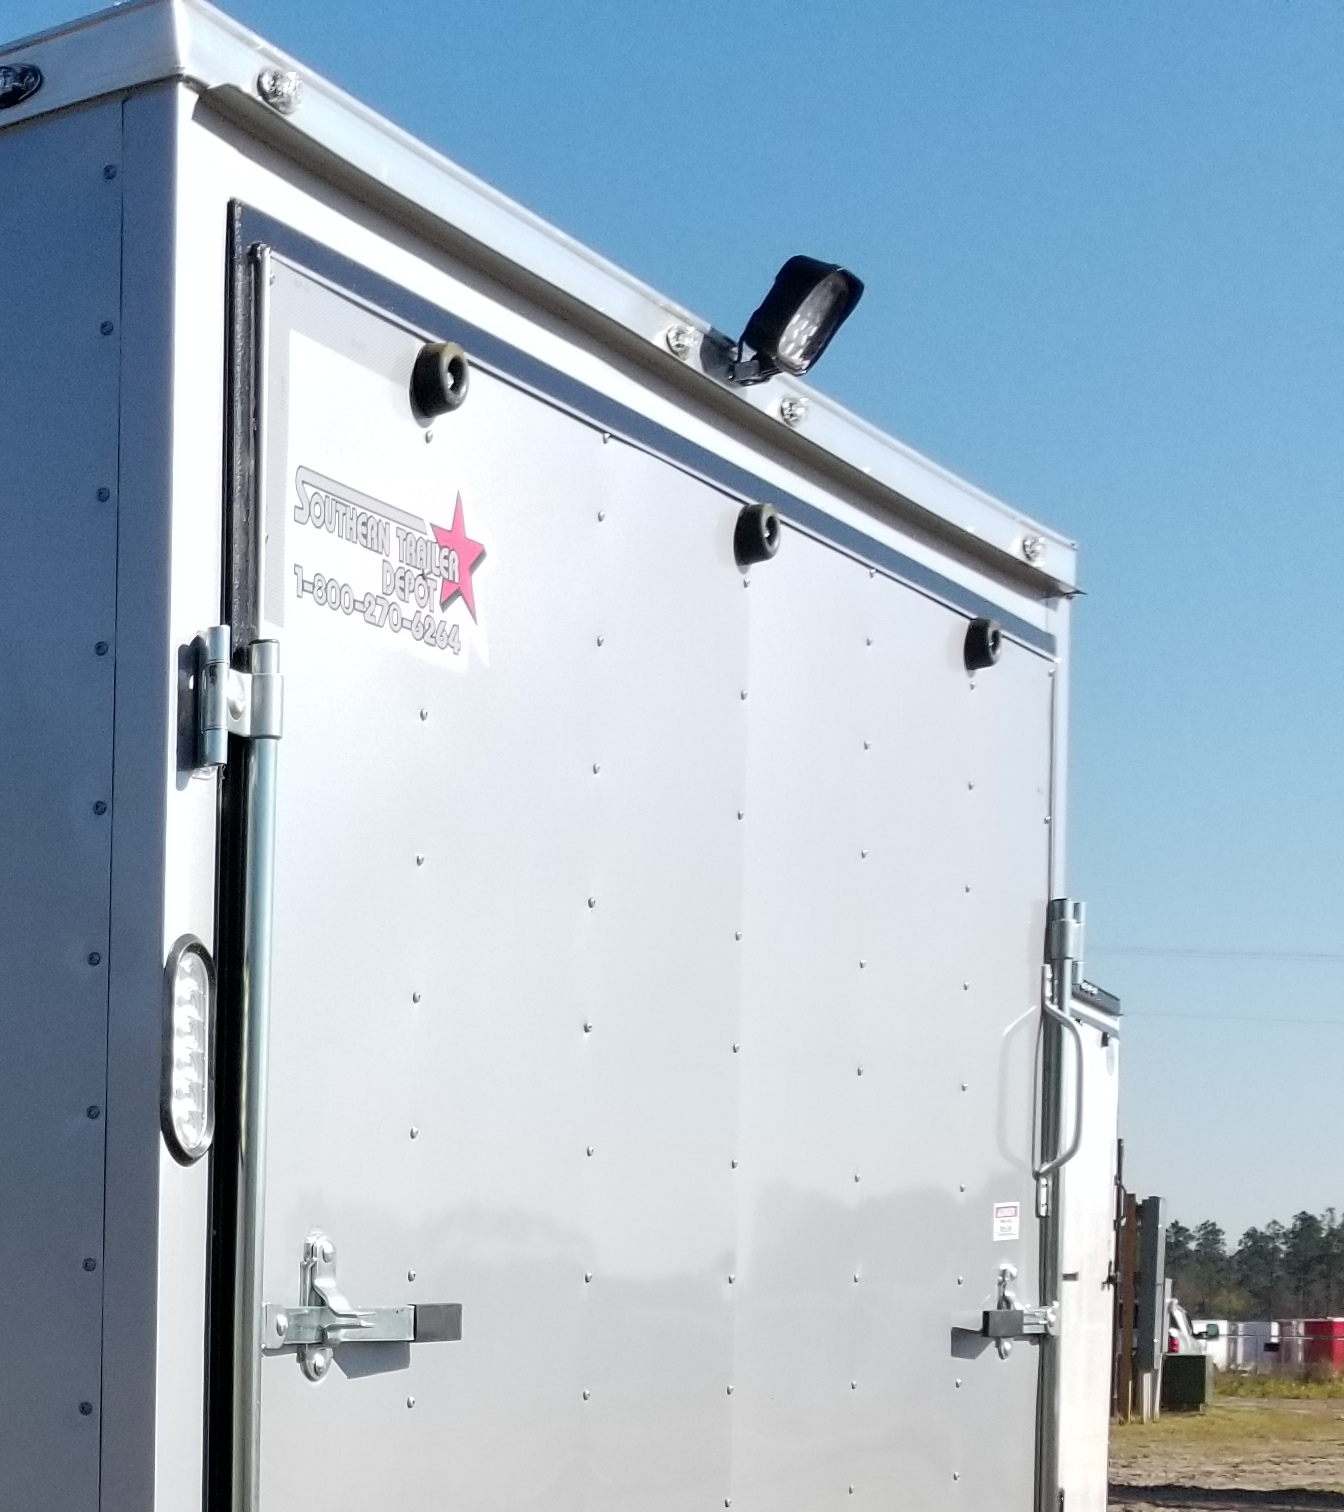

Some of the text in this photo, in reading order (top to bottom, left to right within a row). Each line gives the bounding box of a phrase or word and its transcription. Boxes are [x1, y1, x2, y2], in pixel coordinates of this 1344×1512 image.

[294, 465, 460, 583] SOUTHERN TRAILER
[293, 564, 461, 655] 1-800-270-6264
[382, 559, 438, 613] DEPOT
